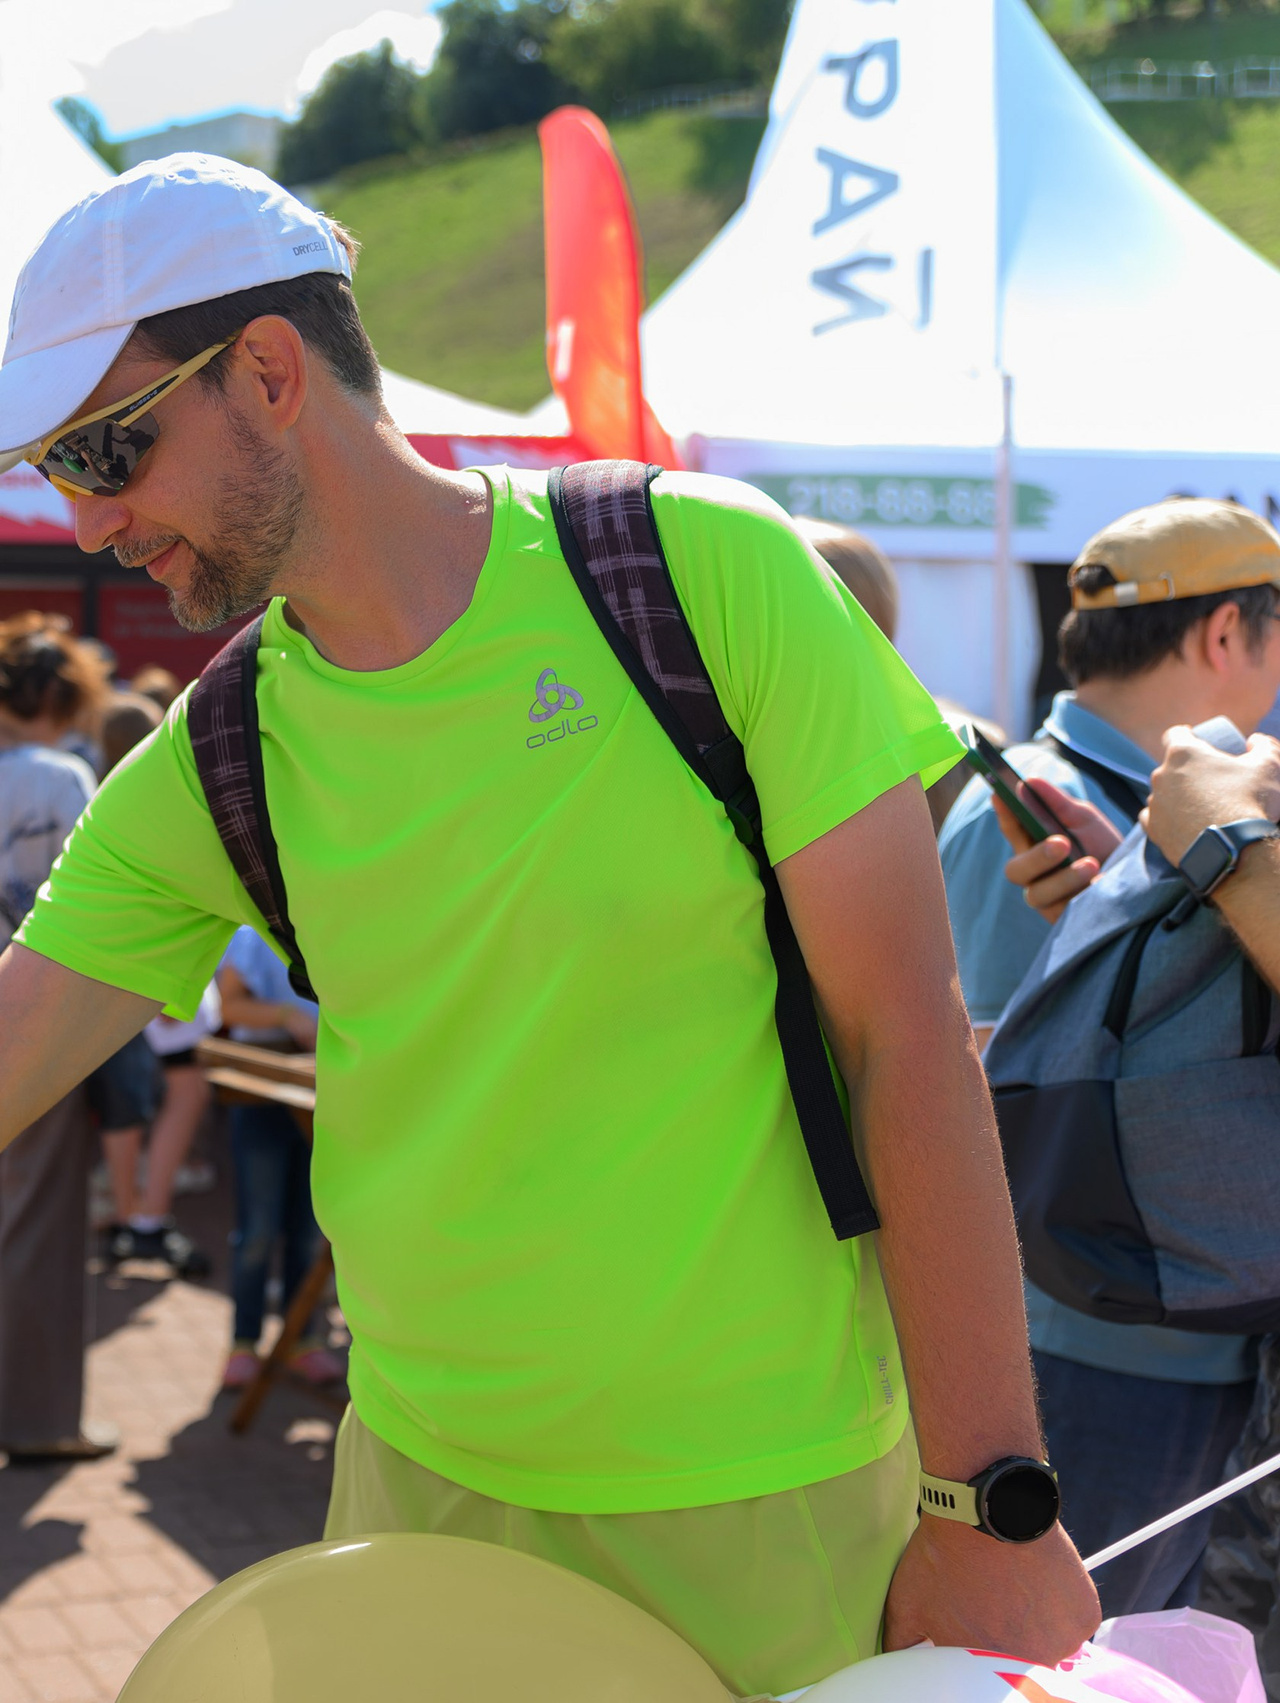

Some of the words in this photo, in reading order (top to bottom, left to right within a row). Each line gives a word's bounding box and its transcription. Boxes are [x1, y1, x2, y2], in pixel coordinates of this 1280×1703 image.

[812, 0, 933, 337] РАЙ
[292, 241, 329, 256] DRYCELL
[526, 714, 599, 749] odlo
[876, 1355, 894, 1405] CHILL-TEC
